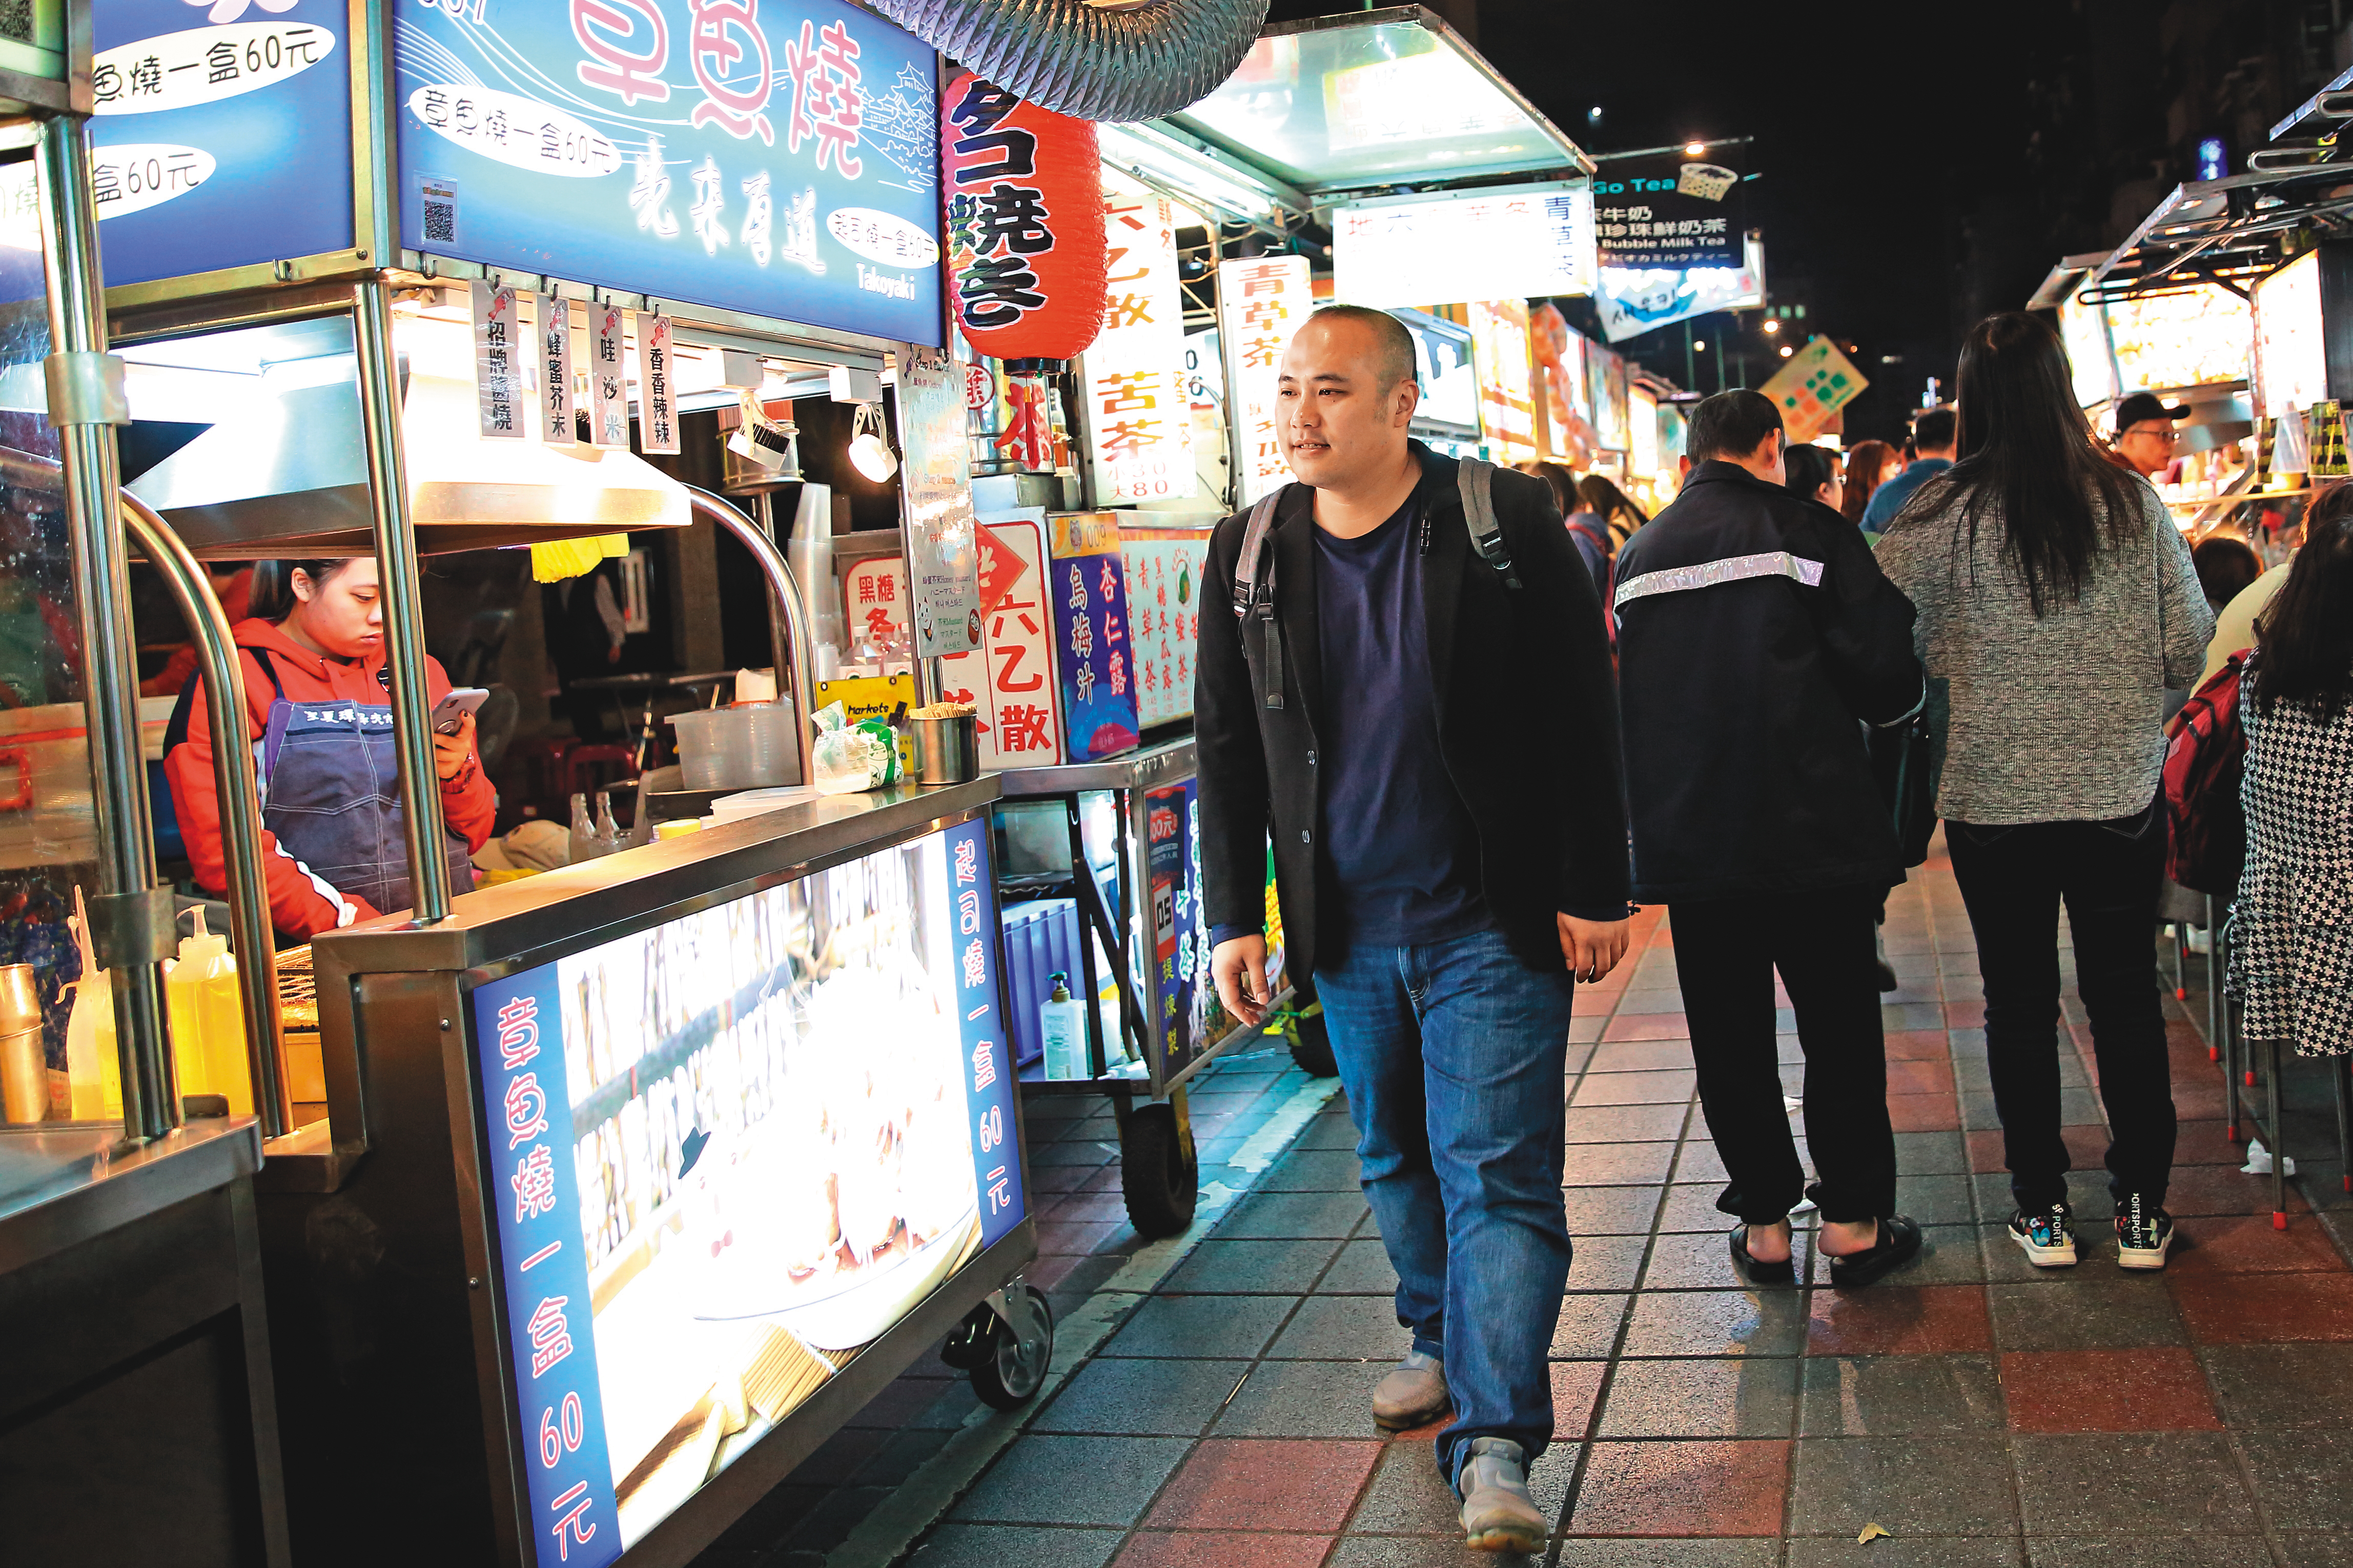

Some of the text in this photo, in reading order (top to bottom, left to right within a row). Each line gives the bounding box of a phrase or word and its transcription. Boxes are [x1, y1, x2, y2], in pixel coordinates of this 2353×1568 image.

[425, 90, 611, 174] 章魚燒一盒60元
[1595, 205, 1653, 222] 牛奶
[1629, 178, 1675, 192] Tea
[1544, 196, 1573, 277] 青草茶
[1602, 236, 1726, 250] Bubble Milk Tea
[856, 261, 915, 301] Takoyaki
[1238, 264, 1292, 368] 青草茶
[547, 333, 566, 438] 蜂蜜芥末
[600, 338, 626, 439] 哇沙米
[649, 348, 671, 445] 香香辣辣
[1097, 371, 1164, 462] 苦茶
[1110, 485, 1129, 501] 大
[1133, 480, 1168, 497] 80
[1132, 461, 1166, 478] 30
[858, 573, 895, 604] 黑糖
[1099, 558, 1127, 697] 杏仁露
[1138, 557, 1157, 692] 青草茶
[991, 593, 1052, 753] 六乙散
[1069, 563, 1095, 705] 烏梅汁
[847, 702, 889, 715] Markets
[1157, 896, 1172, 931] 05
[955, 838, 1011, 1216] 起司燒一盒60元
[497, 995, 597, 1562] 章魚燒一盒60元
